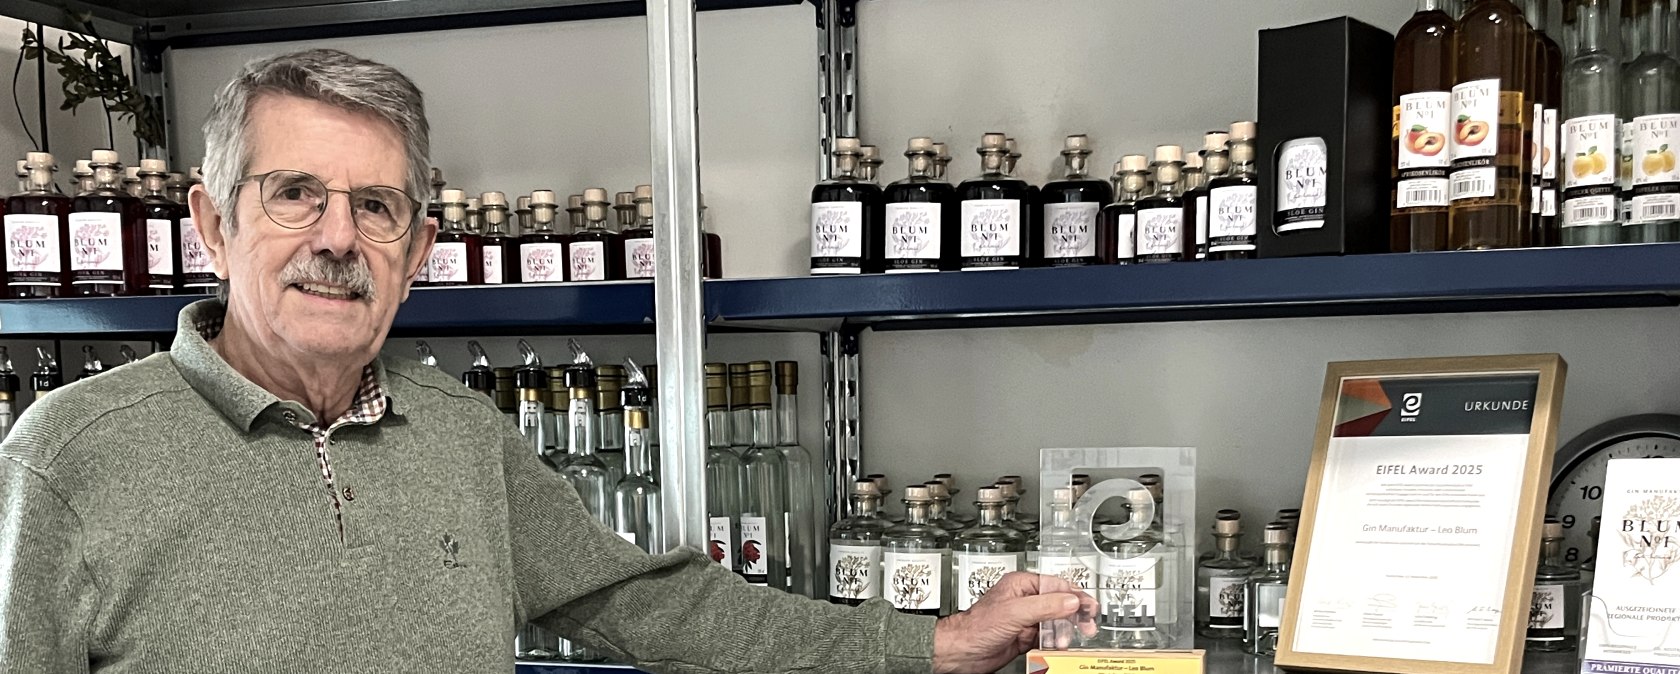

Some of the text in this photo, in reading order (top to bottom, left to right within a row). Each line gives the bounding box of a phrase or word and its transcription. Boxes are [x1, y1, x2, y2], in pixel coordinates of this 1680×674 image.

[1454, 88, 1489, 101] BLUM
[1405, 100, 1446, 111] BLUM
[1569, 121, 1609, 134] BLUM
[1640, 121, 1678, 131] BLUM
[1218, 206, 1253, 214] BLUM
[815, 225, 848, 233] BLUM
[892, 226, 927, 234] BLUM
[970, 223, 1008, 232] BLUM
[1051, 225, 1088, 234] BLUM
[10, 239, 45, 248] BLUM
[74, 237, 107, 246] BLUM
[183, 241, 201, 251] BLU
[632, 253, 655, 261] BLU
[1464, 400, 1529, 412] URKUNDE
[1376, 464, 1483, 475] EIFEL Award 2025
[1580, 485, 1602, 501] 10
[1561, 514, 1576, 529] 9
[1362, 523, 1377, 533] Gin
[1378, 524, 1429, 534] Manufaktur
[1437, 525, 1453, 534] Leo
[1454, 526, 1478, 535] Blum
[1564, 547, 1579, 562] 8
[893, 577, 929, 586] BLUM
[968, 580, 994, 589] BLU
